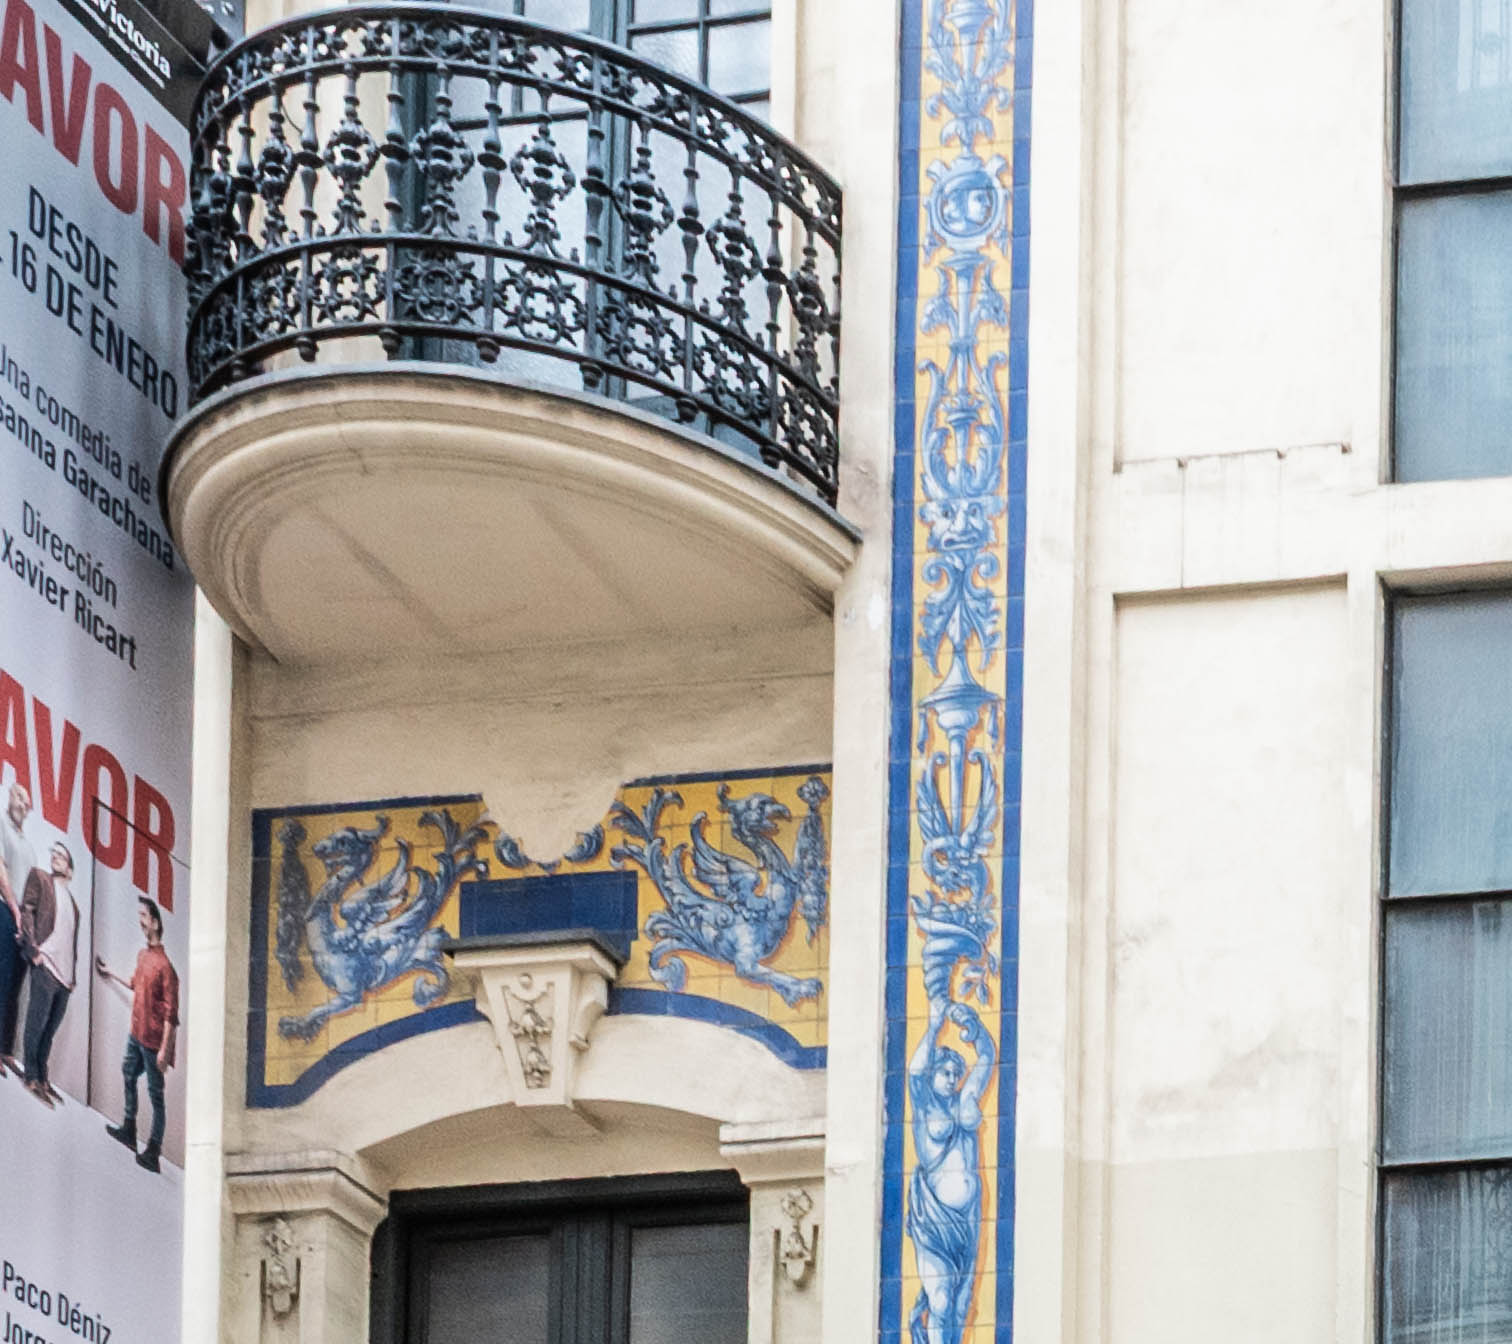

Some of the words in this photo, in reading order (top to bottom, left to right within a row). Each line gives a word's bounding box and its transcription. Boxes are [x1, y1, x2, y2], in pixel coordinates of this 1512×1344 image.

[29, 184, 119, 309] DESDE
[9, 229, 37, 293] 16
[45, 264, 83, 336] DE
[90, 302, 177, 420] ENERO
[36, 385, 121, 480] comedia
[128, 460, 150, 505] de
[22, 500, 117, 609] Dirección
[63, 448, 174, 571] Garachana
[0, 528, 70, 613] Xavier
[74, 588, 137, 671] Ricart
[2, 1260, 51, 1316] Paco
